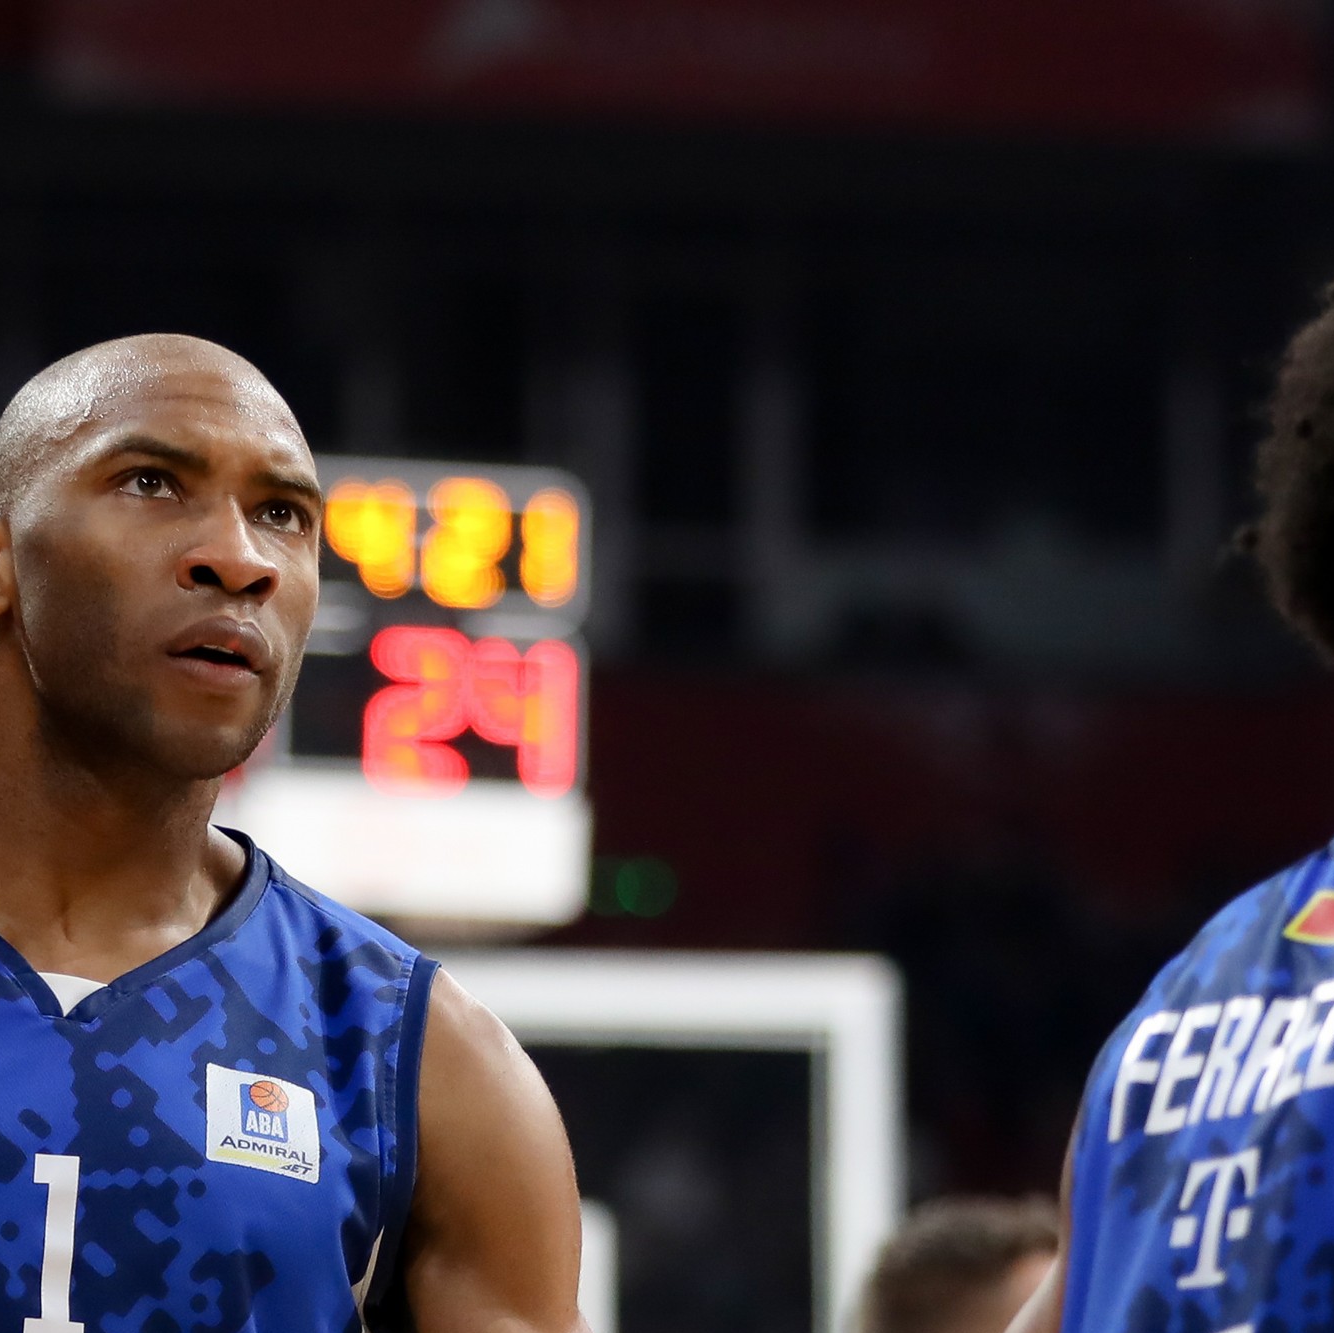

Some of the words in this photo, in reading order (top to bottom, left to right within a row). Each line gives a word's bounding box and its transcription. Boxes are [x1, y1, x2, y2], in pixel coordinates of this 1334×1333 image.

[362, 625, 579, 800] 24
[245, 1110, 285, 1139] ABA
[220, 1135, 314, 1167] ADMIRAL
